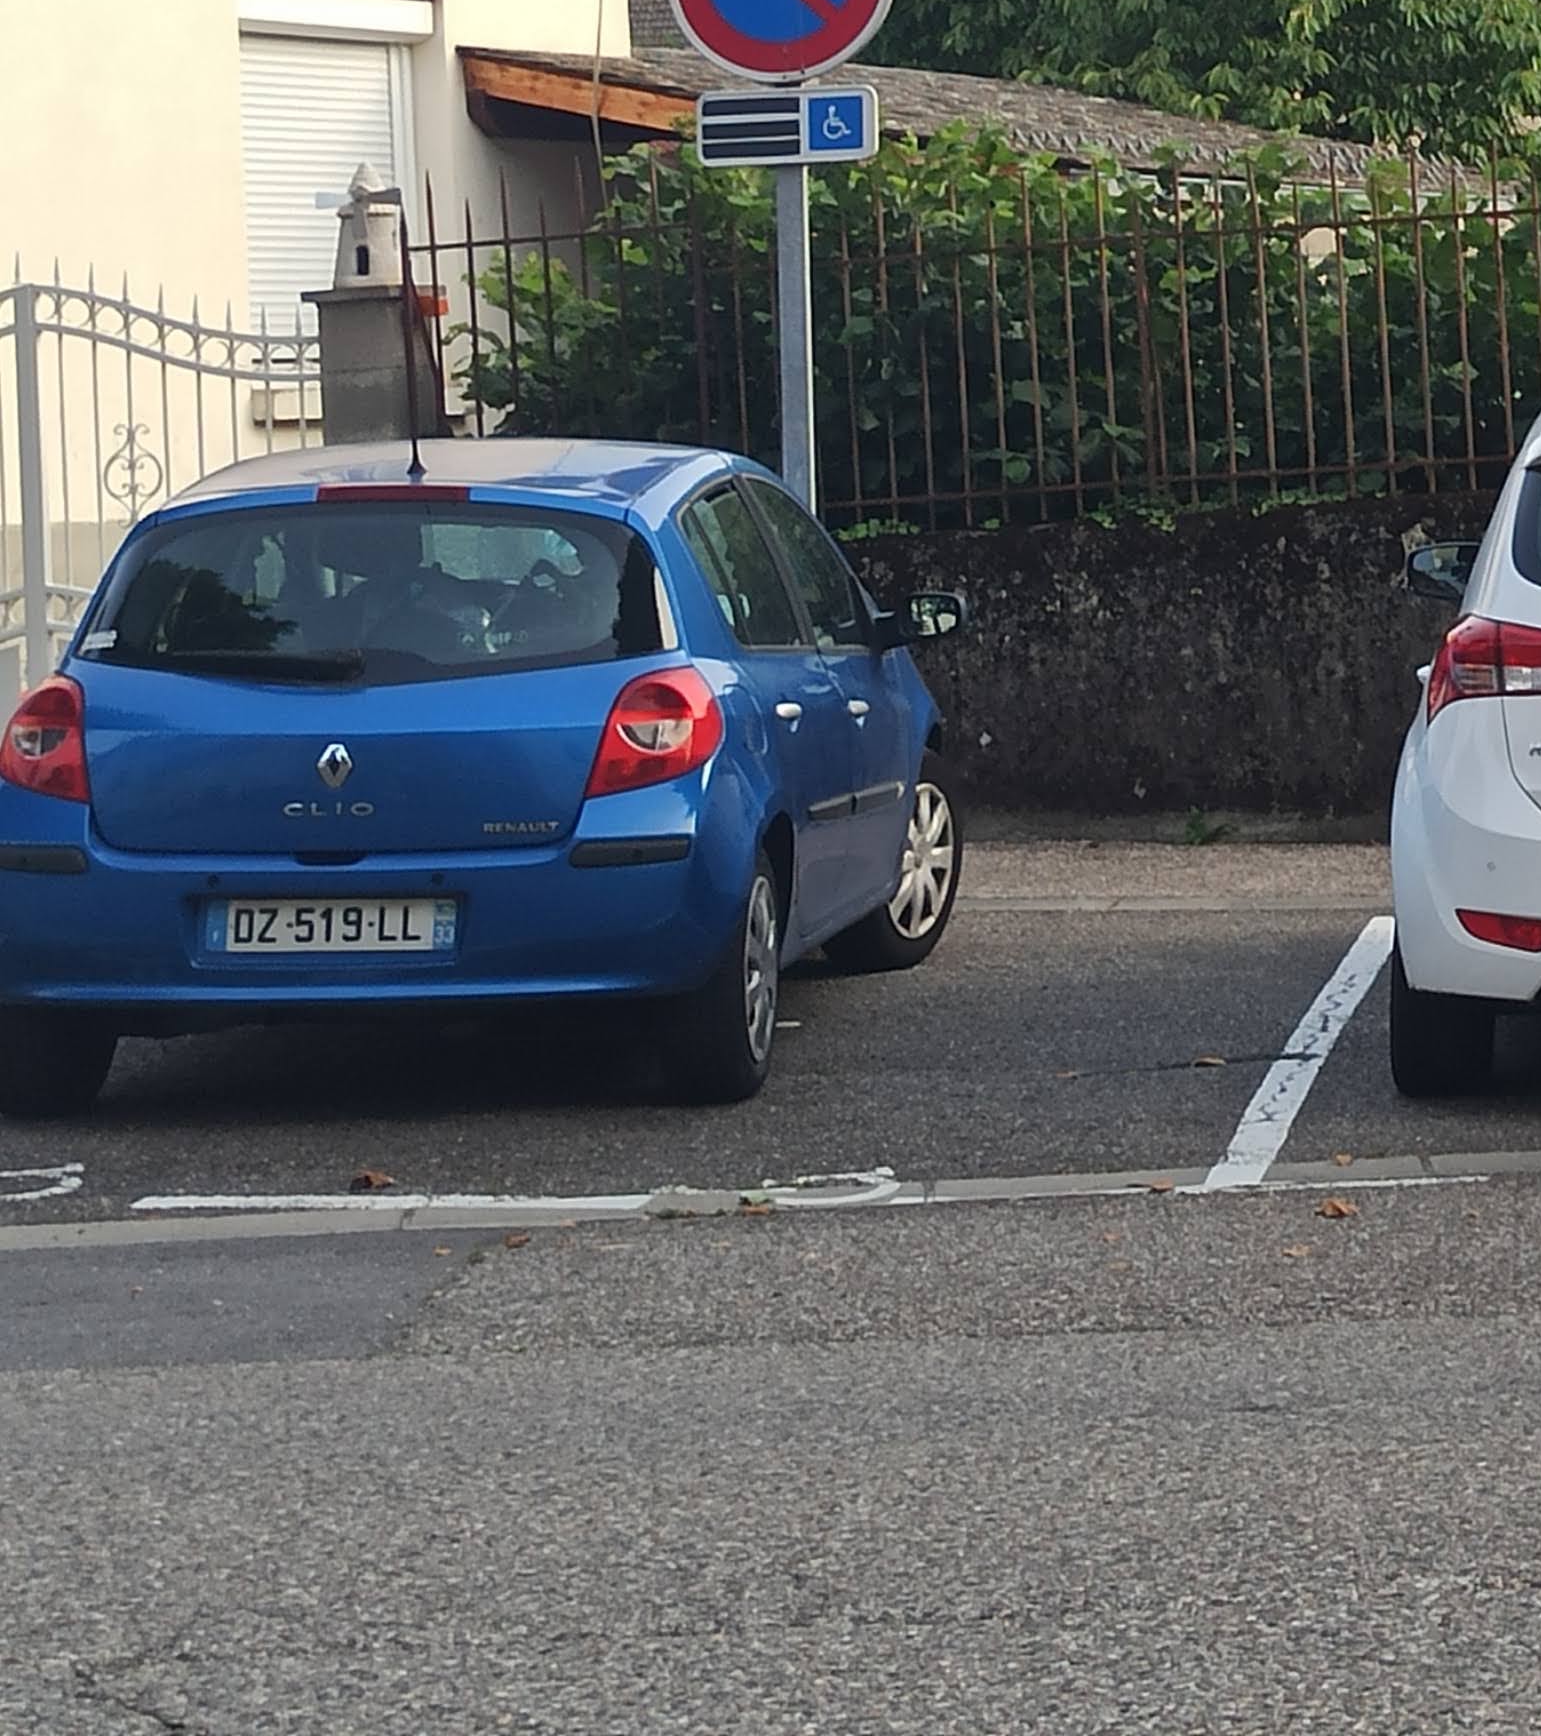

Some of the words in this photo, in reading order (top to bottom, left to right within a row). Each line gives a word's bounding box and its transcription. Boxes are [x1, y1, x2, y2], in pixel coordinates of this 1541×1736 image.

[283, 802, 374, 816] CLIO
[482, 820, 560, 833] RENAULT
[233, 906, 422, 944] DZ-519-LL
[434, 930, 455, 945] 33
